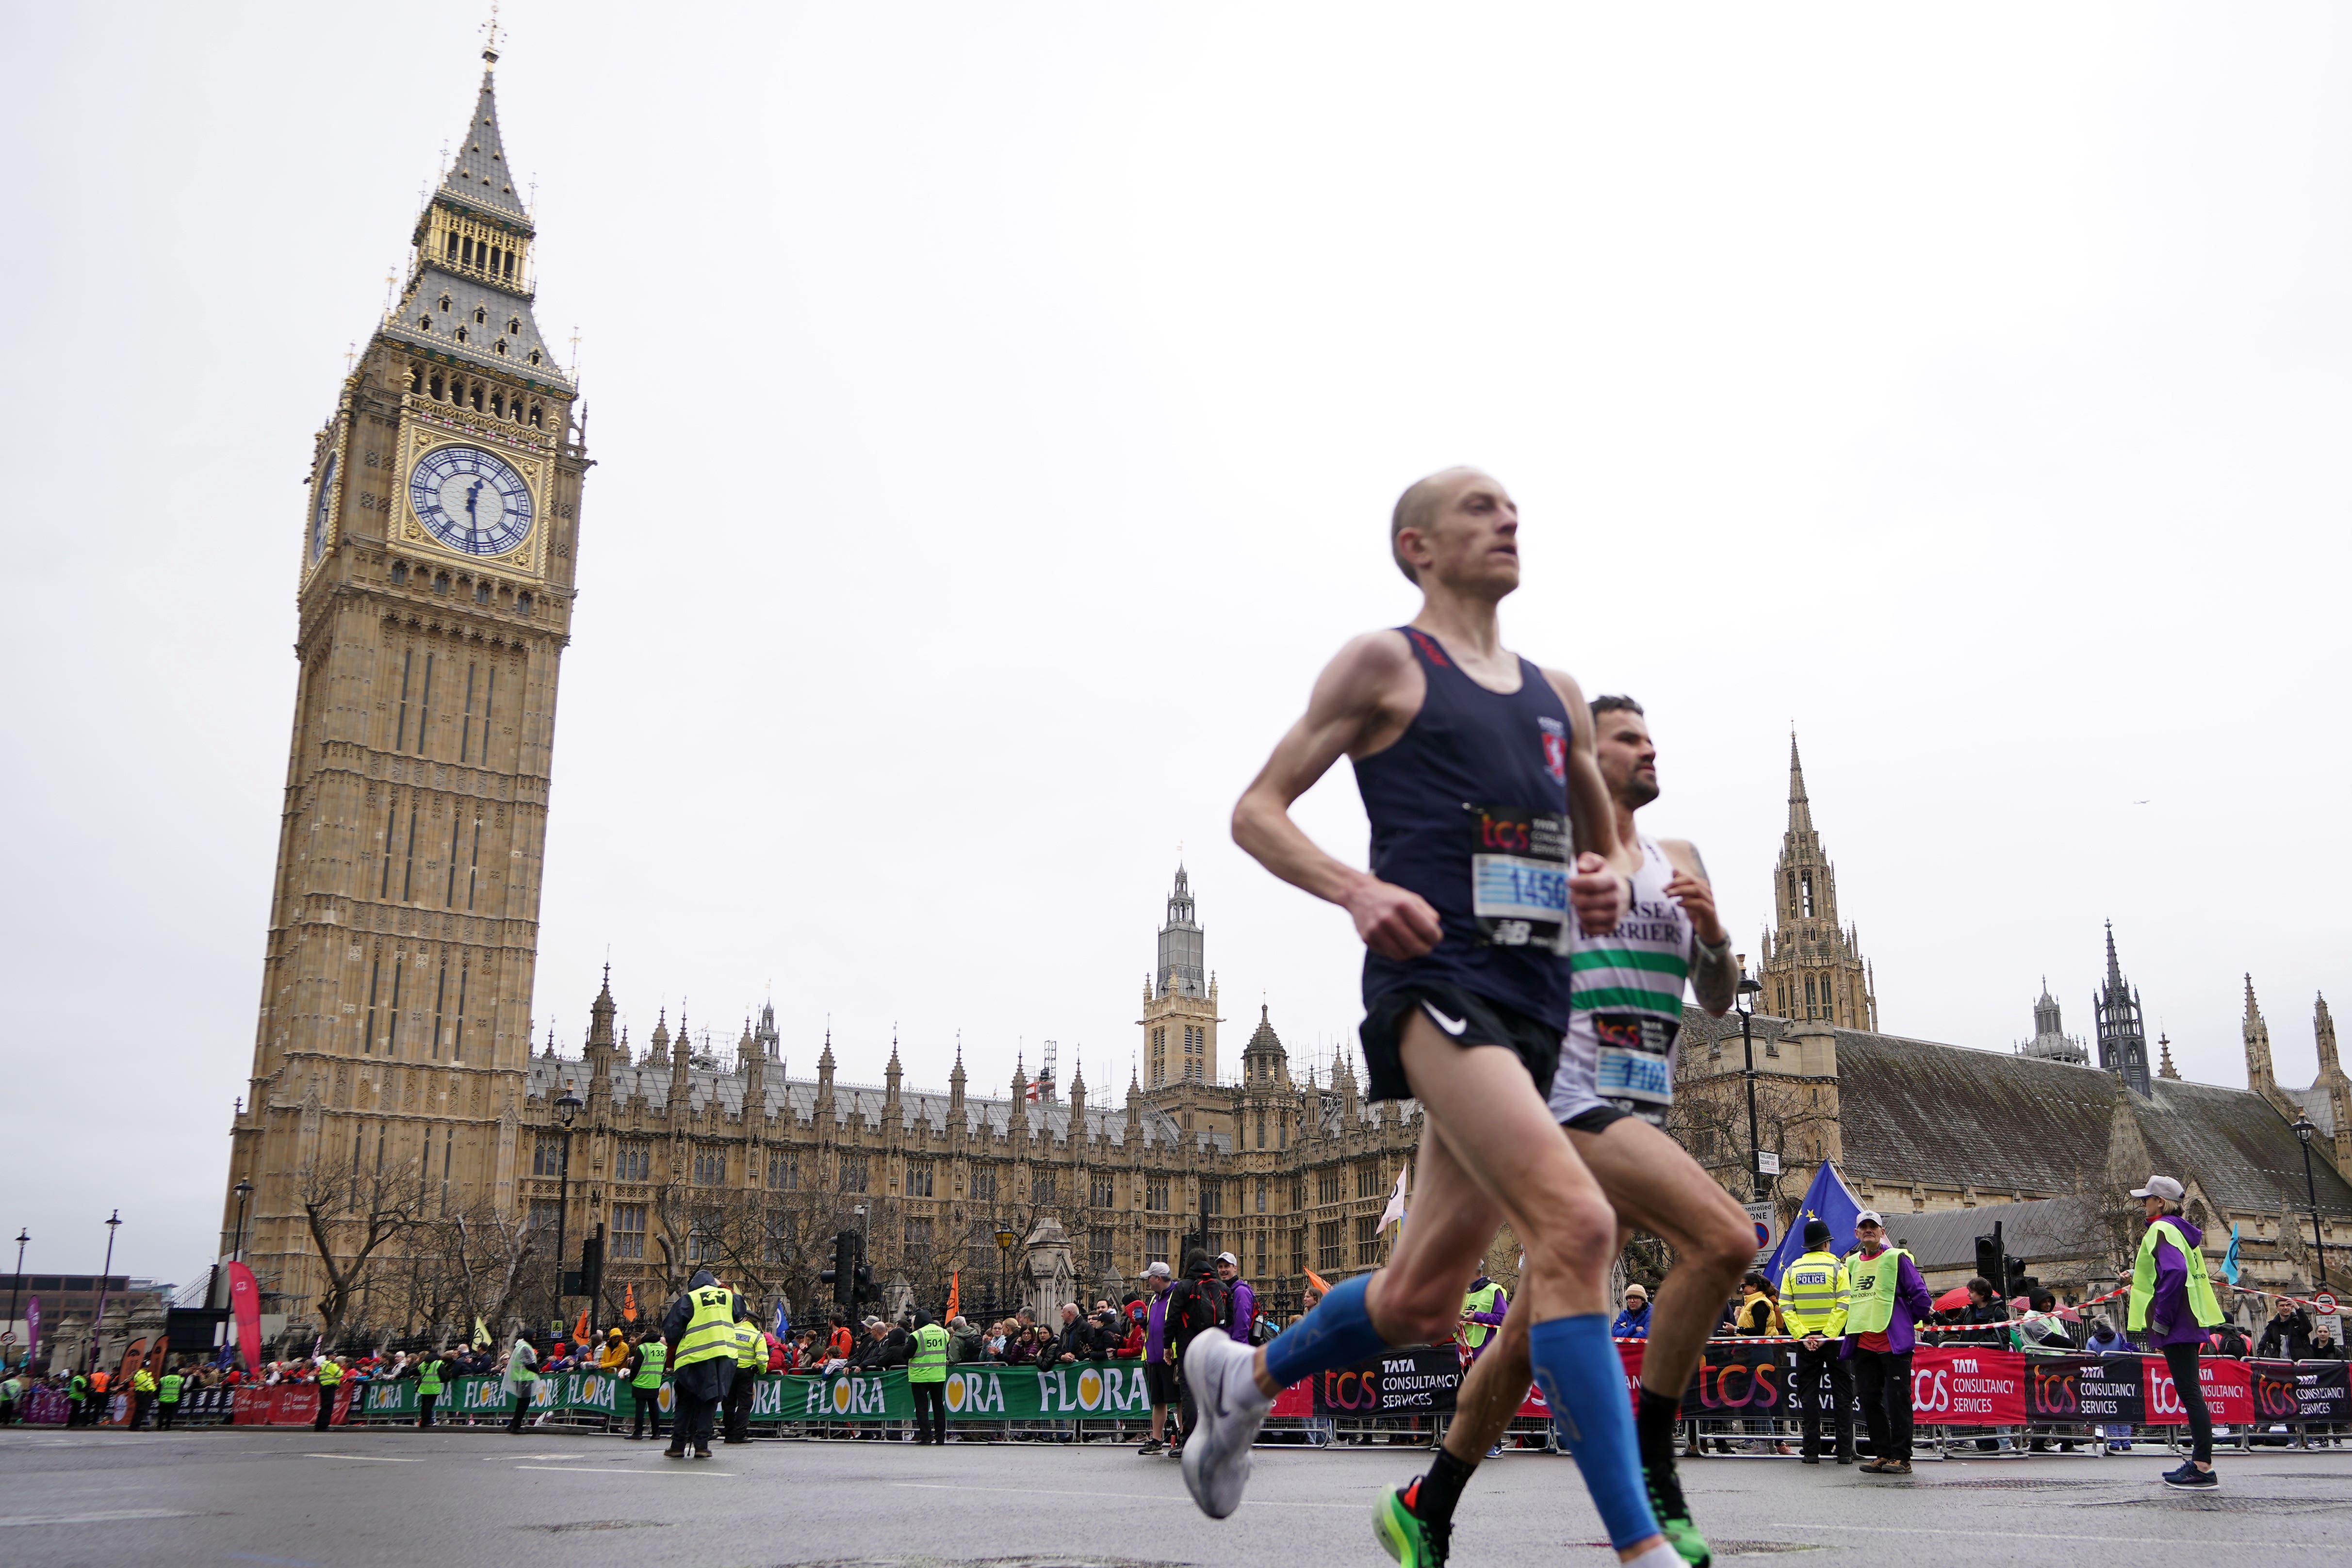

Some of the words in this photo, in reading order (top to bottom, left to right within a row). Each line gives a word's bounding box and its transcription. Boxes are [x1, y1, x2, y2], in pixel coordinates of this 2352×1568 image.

[1482, 813, 1528, 849] tcs
[1630, 900, 1680, 921] NSEA
[1598, 1020, 1640, 1046] tcs
[1797, 1275, 1825, 1284] POLICE
[927, 1338, 942, 1348] 501
[1382, 1359, 1416, 1373] TATA
[1952, 1359, 1978, 1373] TATA
[2080, 1366, 2105, 1378] TATA
[1037, 1368, 1150, 1411] FLORA
[1324, 1369, 1376, 1410] tcs
[1383, 1374, 1459, 1391] CONSULTANCY
[1699, 1354, 1777, 1407] tcs
[1953, 1378, 2014, 1394] CONSULTANCY
[2034, 1365, 2076, 1413] tcs
[2080, 1383, 2135, 1397] CONSULTANCY
[368, 1384, 402, 1408] FLORA
[464, 1381, 506, 1408] FLORA
[567, 1374, 616, 1410] FLORA
[806, 1377, 886, 1415] FLORA
[943, 1373, 1005, 1413] ORA
[2151, 1367, 2188, 1414] tc
[2200, 1385, 2243, 1398] NSULTANCY
[2259, 1374, 2297, 1415] tcs
[2296, 1387, 2344, 1400] CONSULTANCY
[1383, 1393, 1433, 1408] SERVICES
[1953, 1398, 1992, 1413] SERVICES
[2081, 1400, 2118, 1414] SERVICES
[2206, 1401, 2225, 1414] VICES
